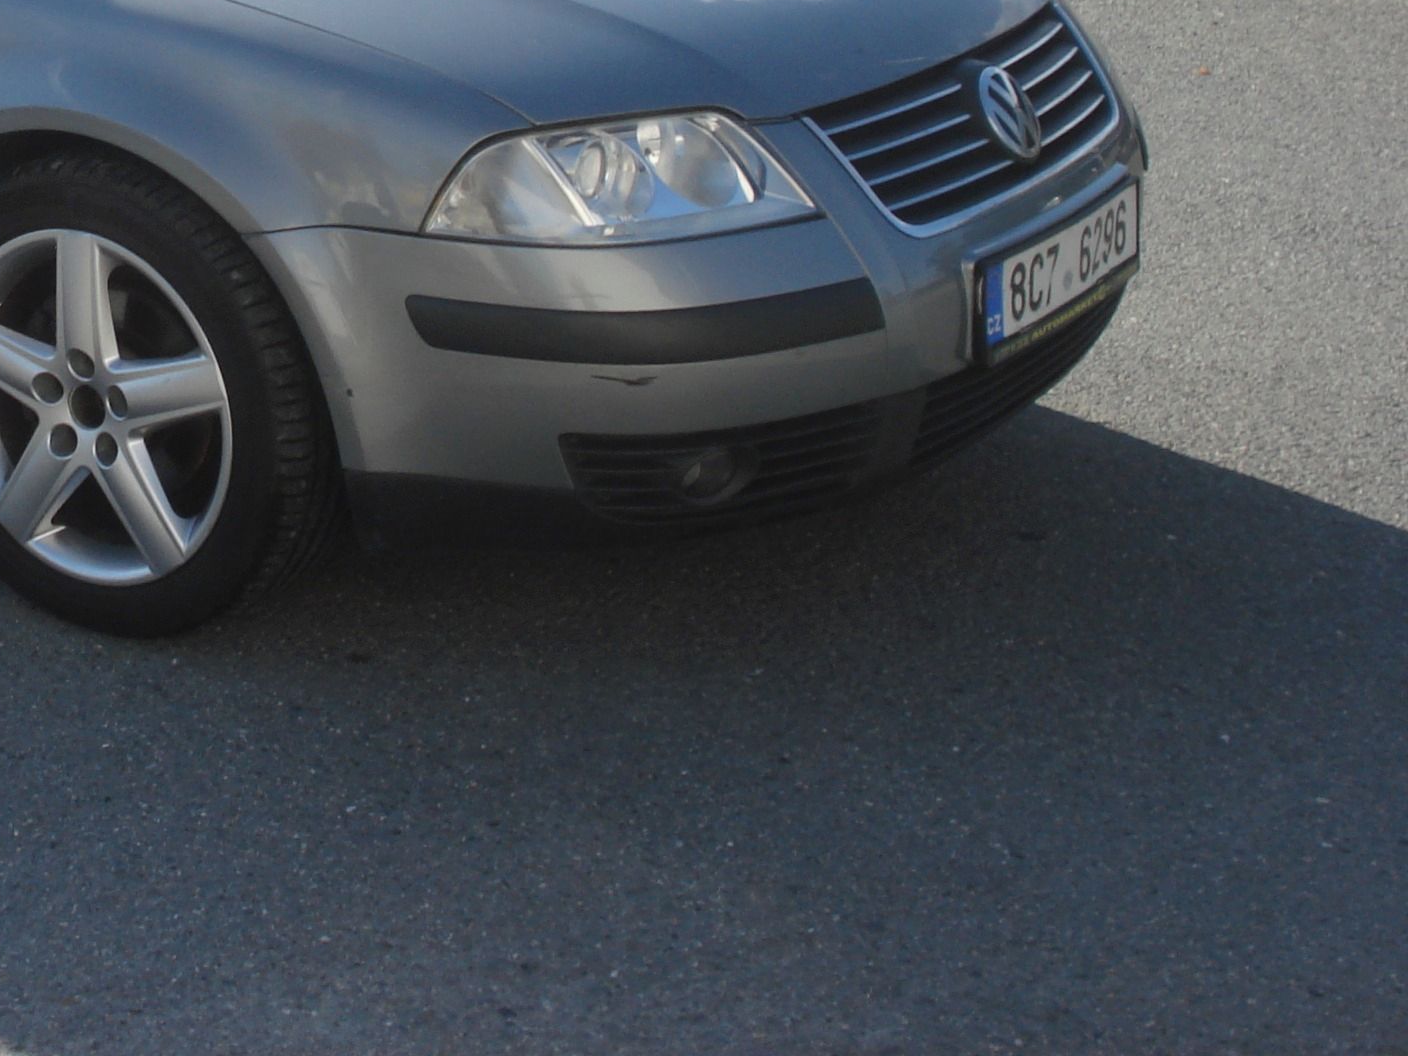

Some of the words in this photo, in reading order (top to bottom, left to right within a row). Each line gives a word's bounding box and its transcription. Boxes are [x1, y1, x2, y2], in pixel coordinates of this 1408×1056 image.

[1010, 243, 1060, 322] 8C7
[1079, 199, 1127, 283] 6296
[987, 313, 1002, 335] CZ
